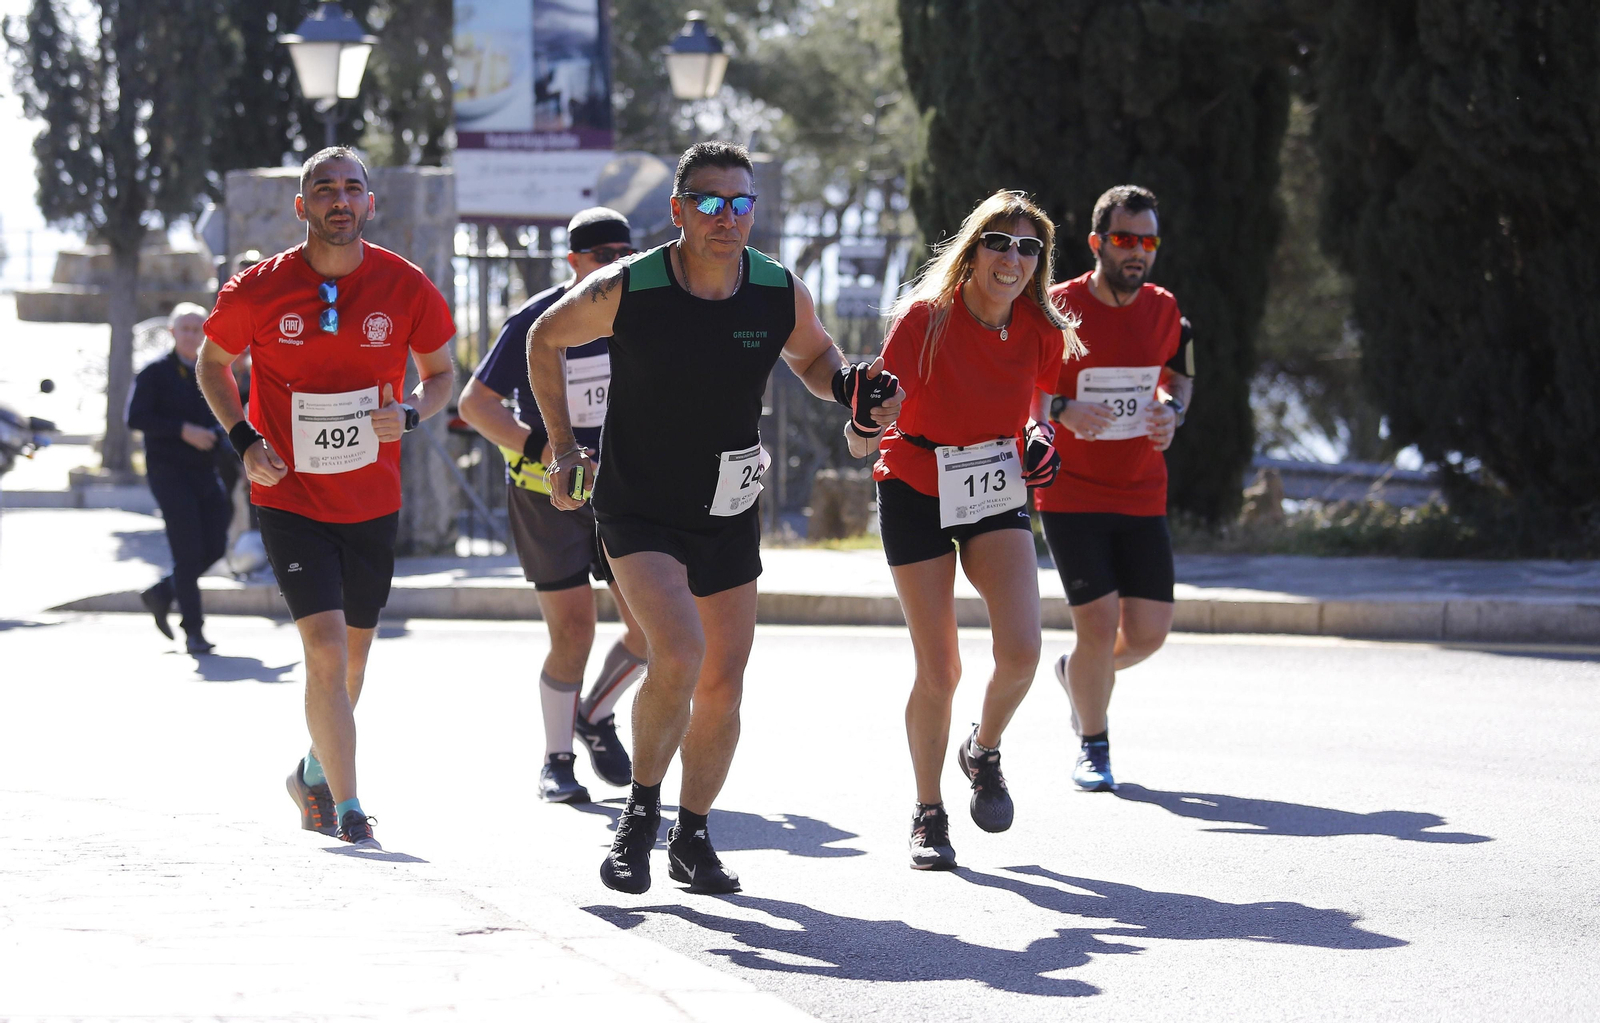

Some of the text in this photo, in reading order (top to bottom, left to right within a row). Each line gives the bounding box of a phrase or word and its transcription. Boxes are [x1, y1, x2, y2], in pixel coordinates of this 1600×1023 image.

[285, 320, 298, 331] FIAT
[742, 340, 760, 348] TEAM
[1103, 398, 1137, 417] 39
[315, 426, 360, 449] 492
[964, 469, 1006, 497] 113
